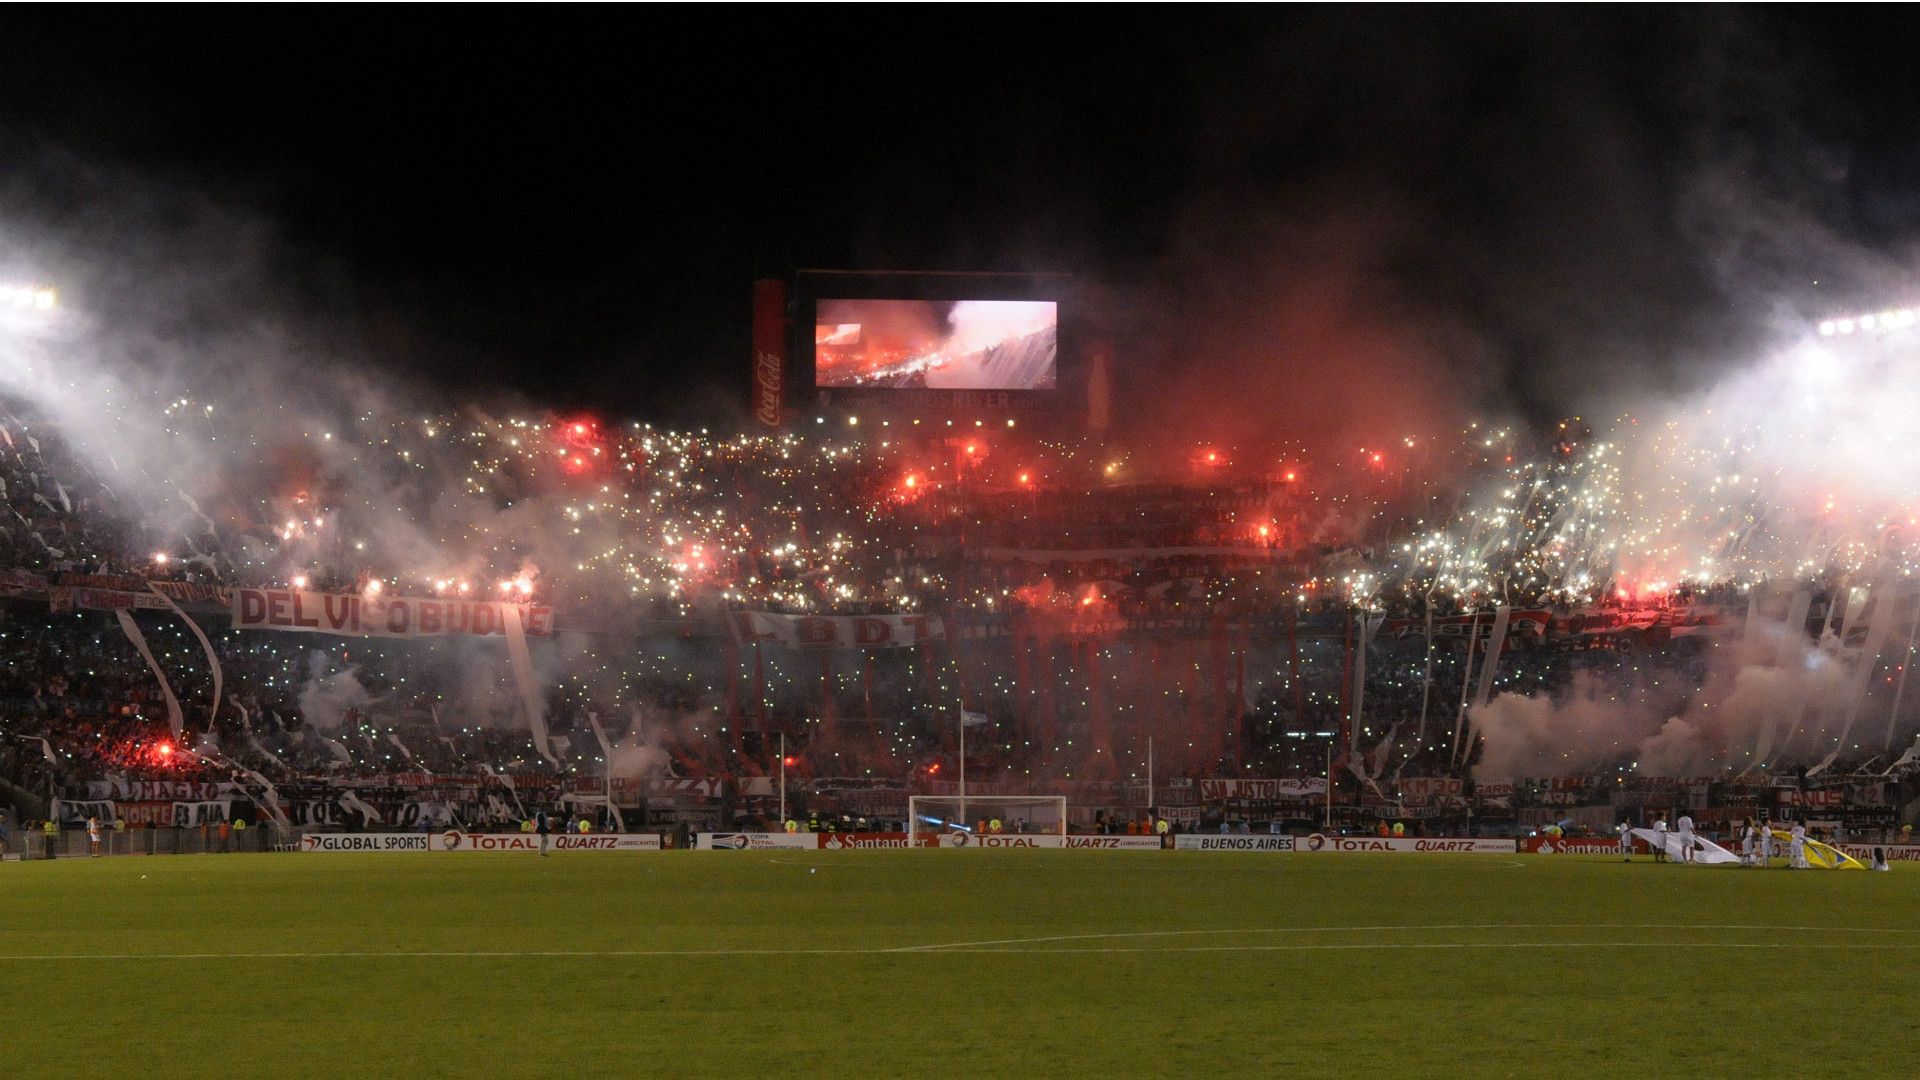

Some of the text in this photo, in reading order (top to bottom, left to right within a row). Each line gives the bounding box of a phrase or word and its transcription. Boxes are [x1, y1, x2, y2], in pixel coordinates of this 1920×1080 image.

[240, 589, 319, 628] DEL
[1201, 780, 1229, 800] SAN
[1231, 780, 1276, 800] JUSTO
[1400, 780, 1428, 794] KM
[115, 804, 171, 825] NORTE
[322, 837, 427, 850] GLOBAL SPORTS
[467, 835, 539, 849] TOTAL
[555, 836, 618, 849] QUARTZ
[974, 835, 1040, 848] TOTAL
[1201, 839, 1254, 850] BUENOS
[1256, 839, 1292, 850] AIRES
[1331, 838, 1397, 851] TOTAL
[1415, 840, 1476, 852] QUARTZ
[1557, 840, 1639, 855] Santandr
